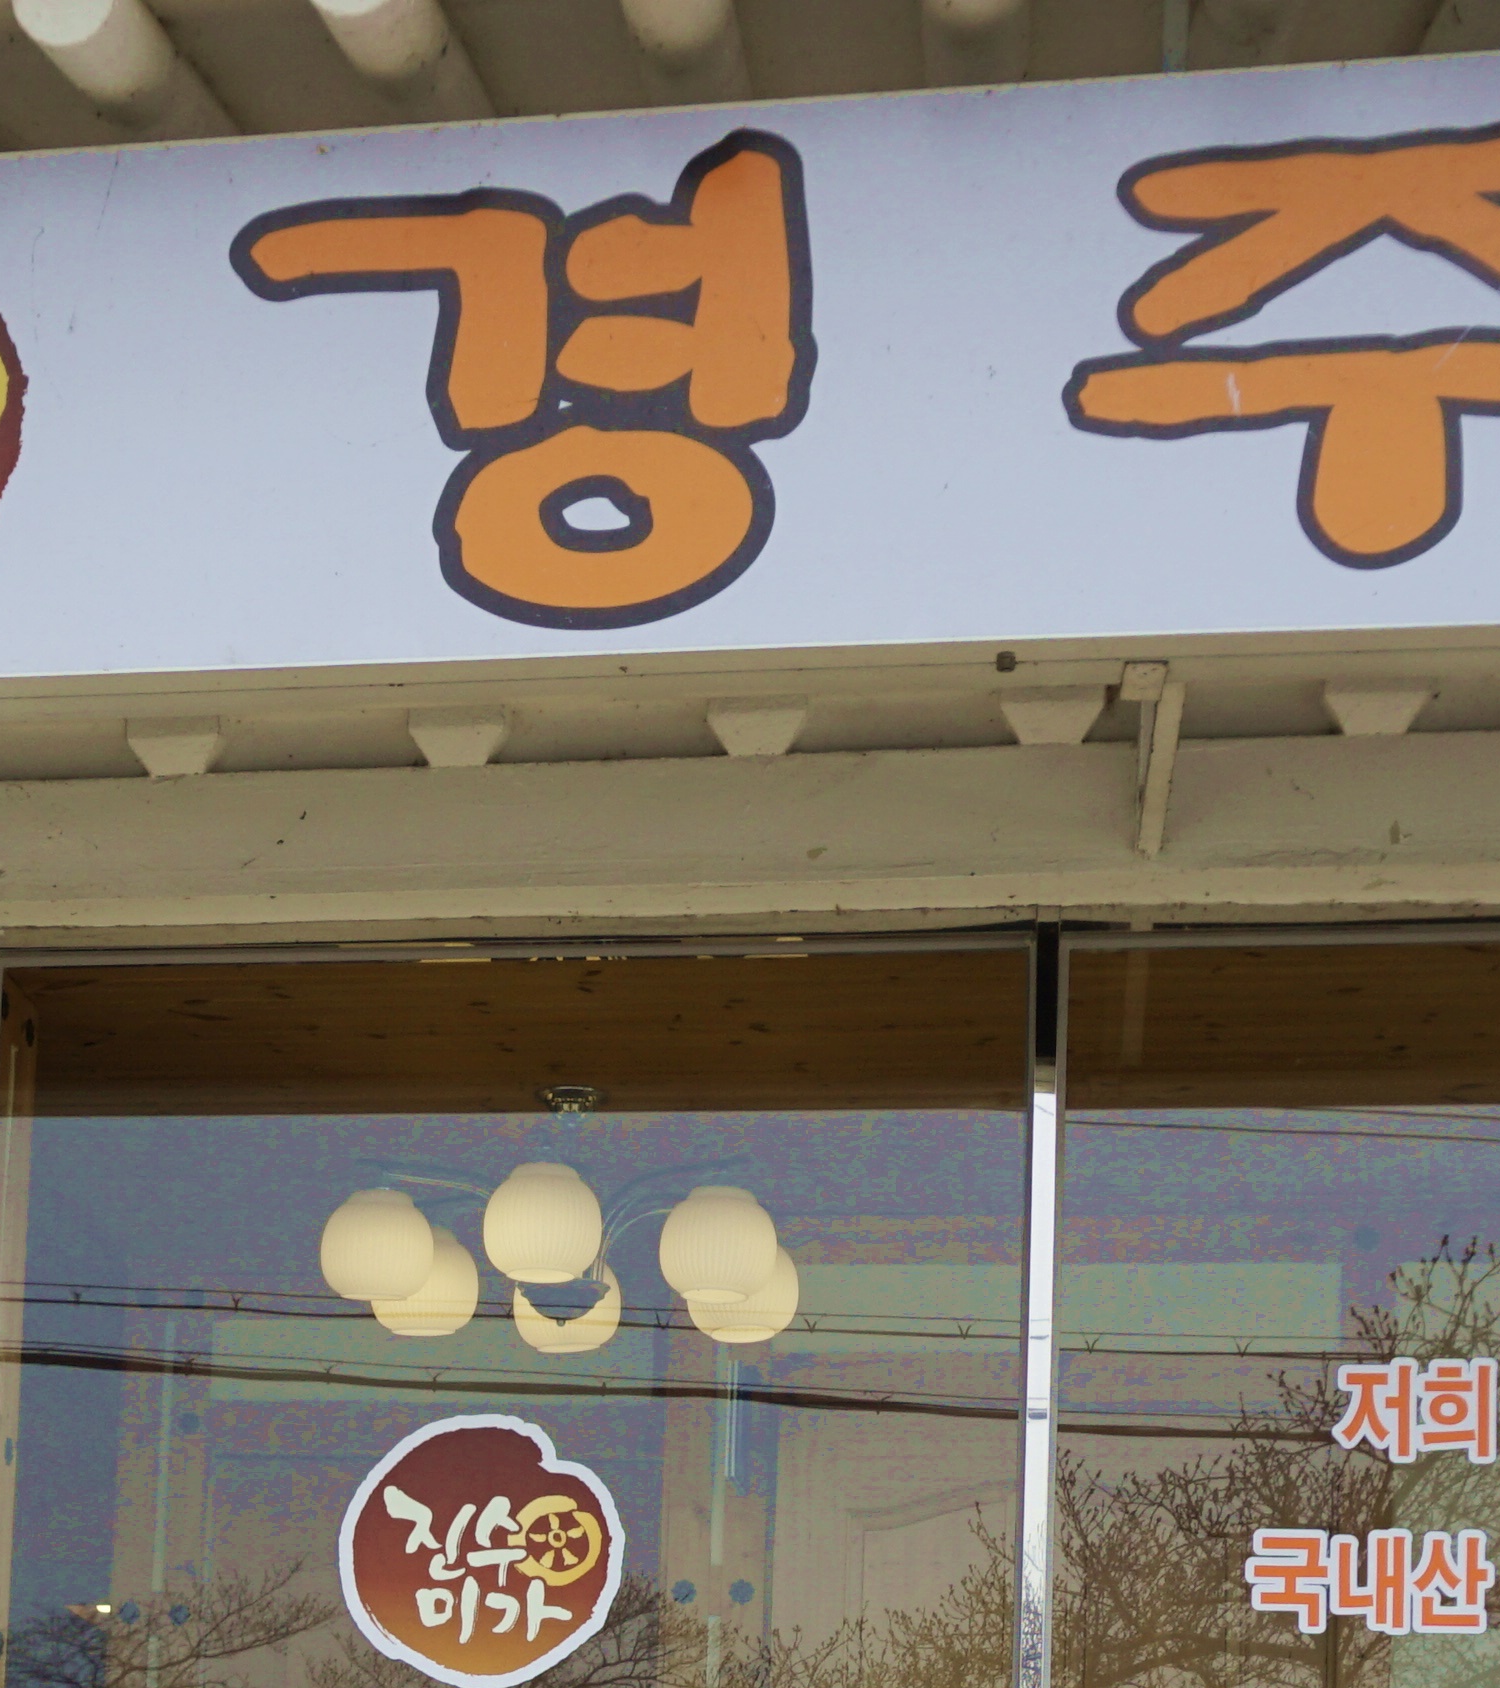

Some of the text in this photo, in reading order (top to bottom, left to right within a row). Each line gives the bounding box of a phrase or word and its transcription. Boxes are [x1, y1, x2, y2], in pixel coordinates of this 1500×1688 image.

[1335, 1357, 1498, 1462] 저희
[383, 1484, 527, 1588] 진수
[1244, 1528, 1494, 1637] 국내산
[414, 1582, 574, 1645] 미가
